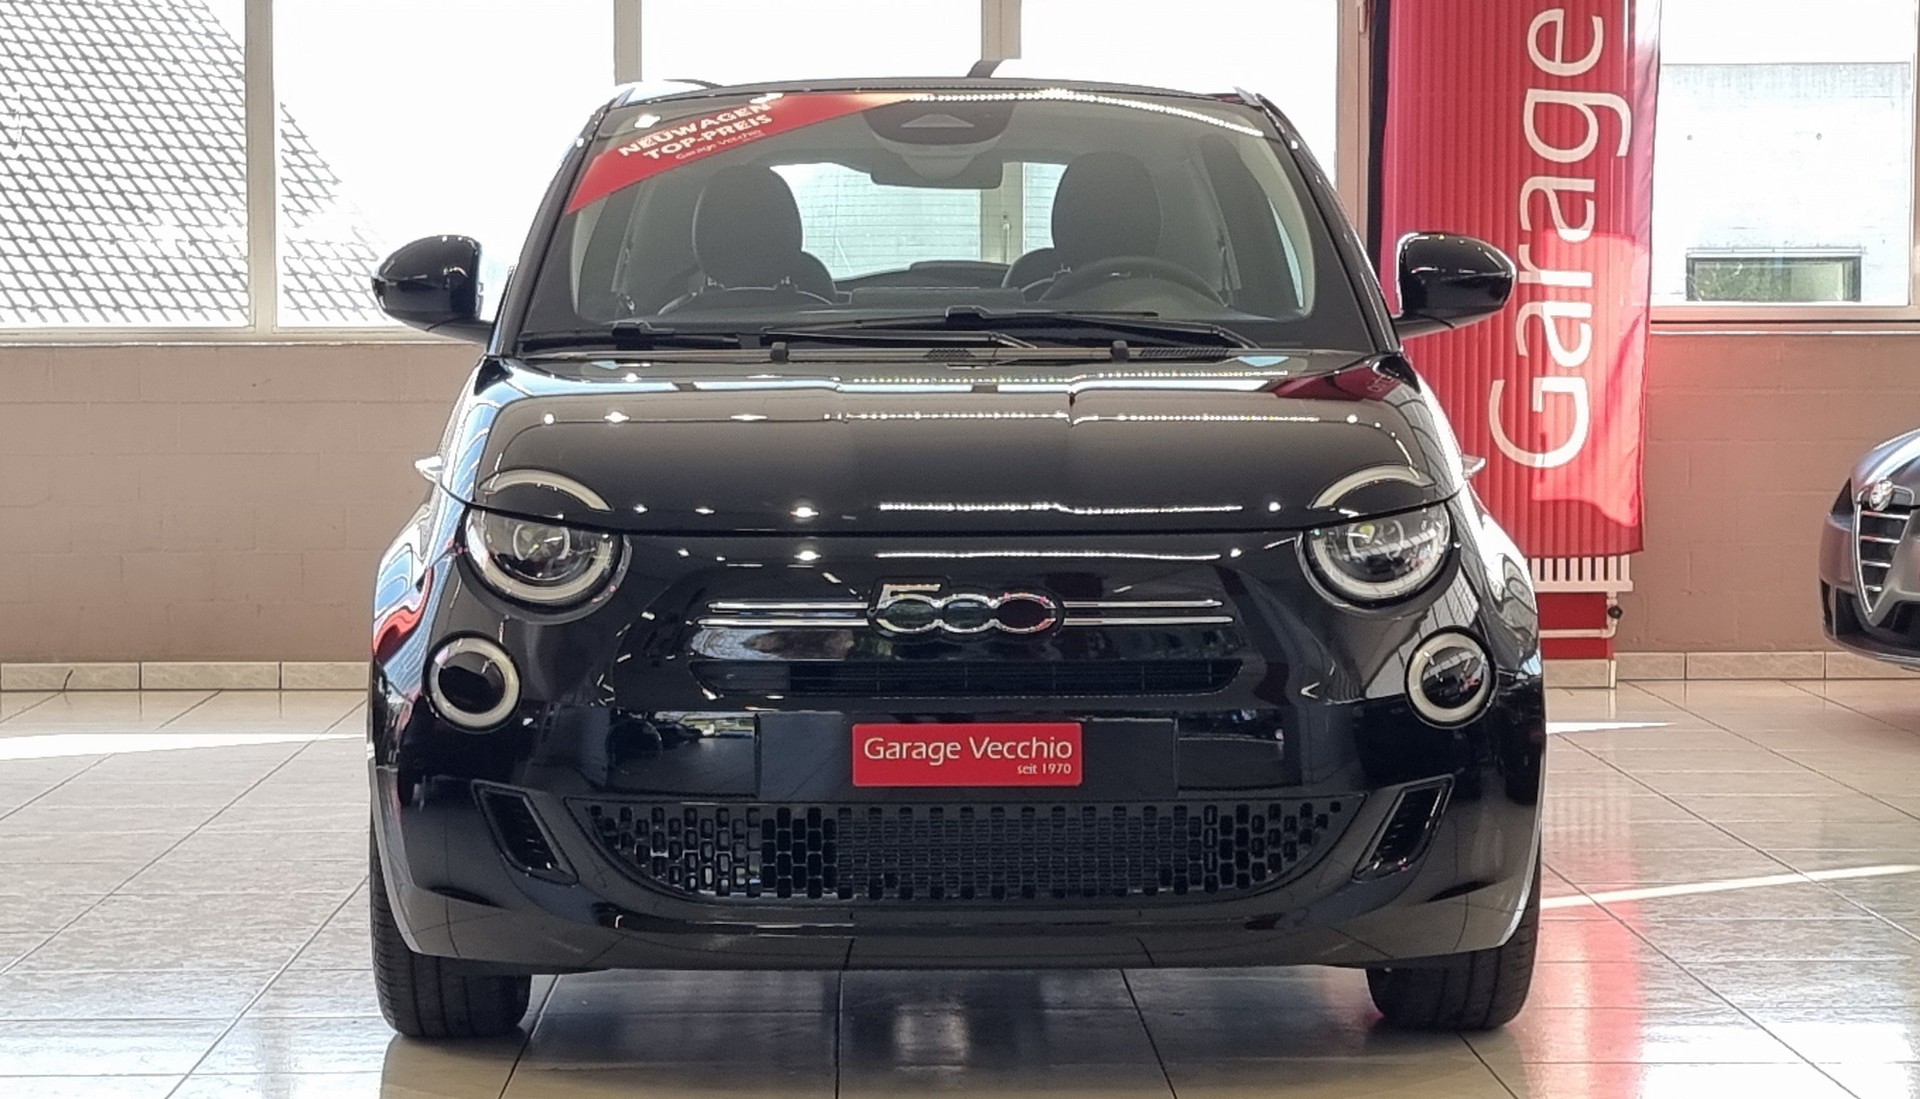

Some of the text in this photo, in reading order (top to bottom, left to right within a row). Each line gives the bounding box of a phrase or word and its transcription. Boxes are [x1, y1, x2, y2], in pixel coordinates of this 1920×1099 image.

[618, 103, 773, 156] NEUWAGEN
[643, 114, 773, 159] TOP-PREIS
[1488, 8, 1633, 469] Garage
[873, 582, 1058, 635] 500
[864, 736, 1073, 766] Garage Vecchio
[1017, 763, 1072, 775] seit 1970
